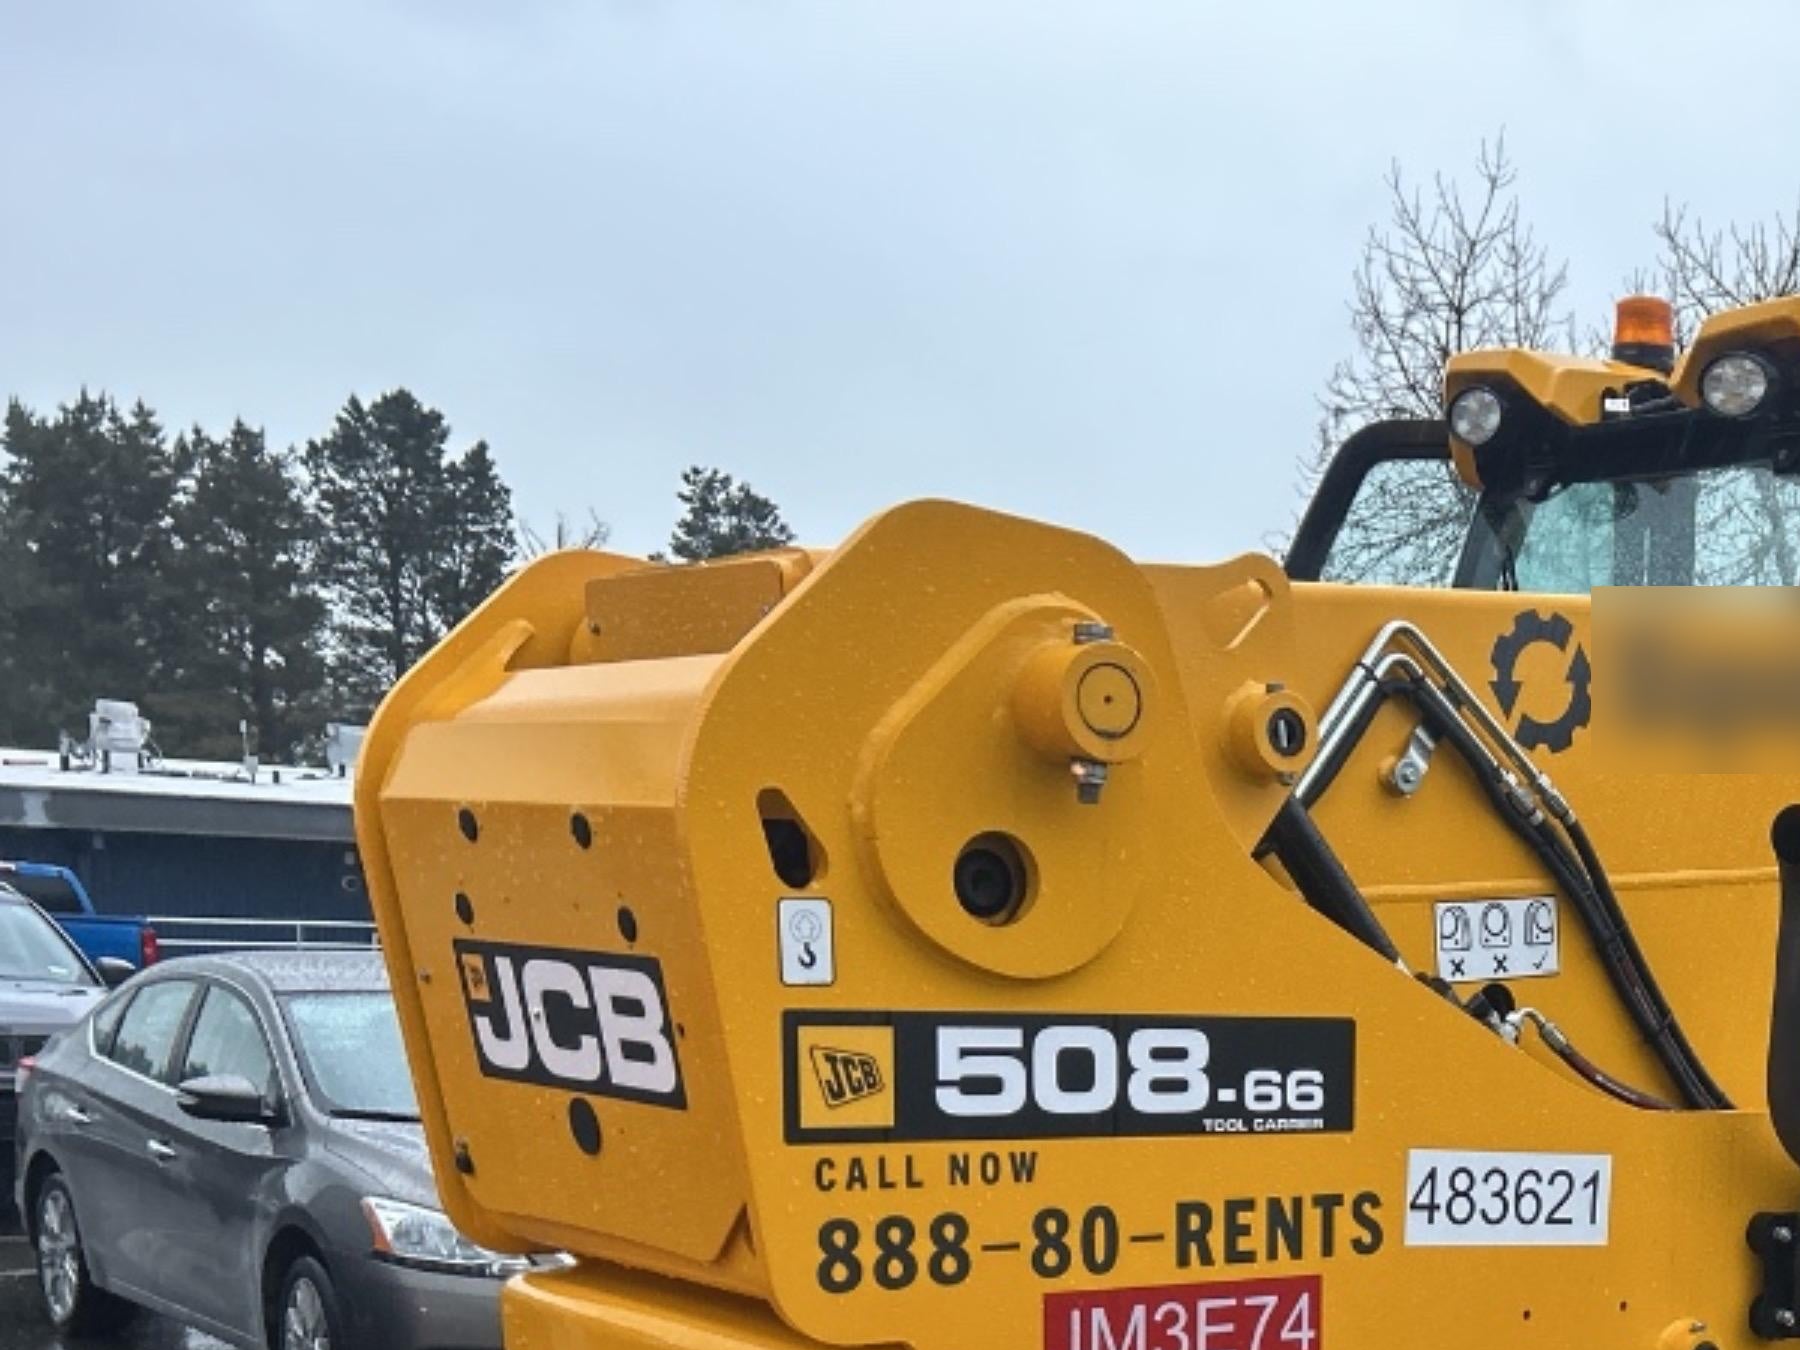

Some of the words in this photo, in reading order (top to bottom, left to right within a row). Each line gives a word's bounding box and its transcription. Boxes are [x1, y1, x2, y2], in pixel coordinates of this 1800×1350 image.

[475, 956, 677, 1093] JCB
[810, 1046, 885, 1108] JCB
[815, 1155, 923, 1192] CALL
[949, 1151, 1038, 1186] NOW
[1409, 1166, 1602, 1226] 483621
[817, 1190, 1384, 1293] 888-80-RENTS
